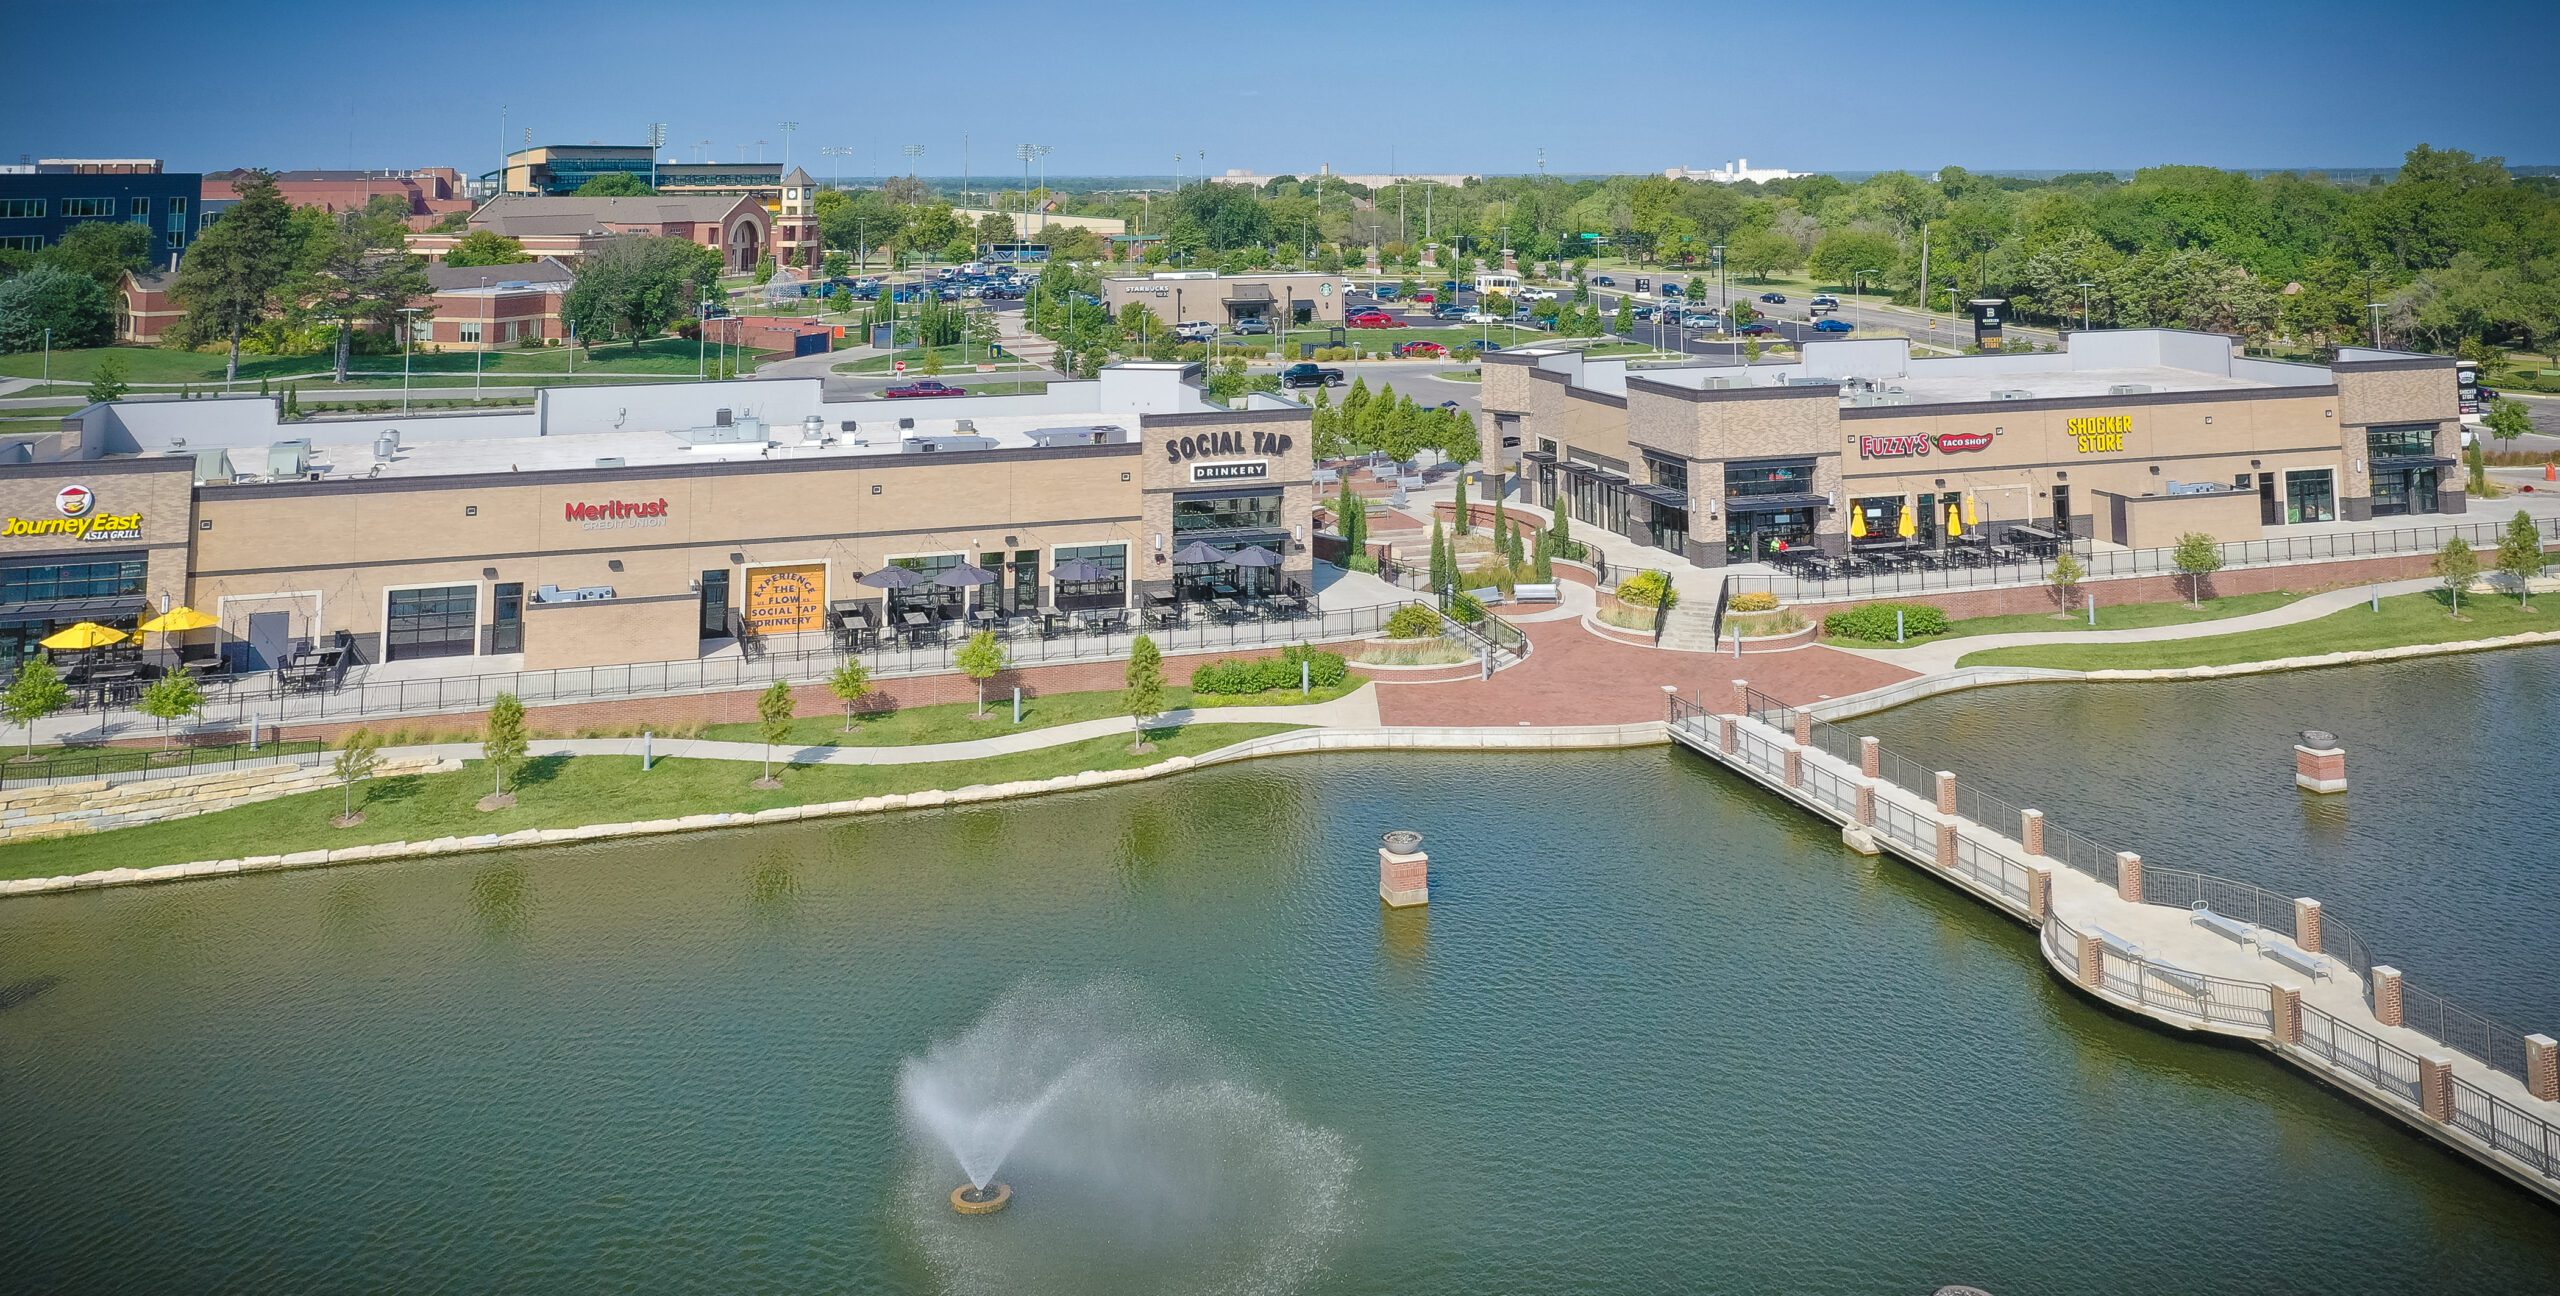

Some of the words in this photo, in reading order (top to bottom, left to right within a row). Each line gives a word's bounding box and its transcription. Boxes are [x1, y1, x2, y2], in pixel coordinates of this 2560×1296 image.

[1125, 285, 1169, 293] STARBUCKS
[2067, 415, 2132, 436] SHOCKER
[1165, 431, 1246, 464] SOCIAL
[1252, 431, 1293, 457] TAP
[1860, 432, 1930, 459] FUZZY'S
[1964, 438, 1987, 446] SHOP
[2078, 434, 2123, 453] STORE
[1196, 465, 1264, 477] DRINKERY
[565, 498, 669, 522] Meritrust
[1, 517, 94, 540] Journey
[92, 512, 143, 532] East
[583, 520, 626, 531] CREDIT
[629, 517, 667, 528] UNION
[83, 531, 108, 540] ASIA
[110, 530, 141, 539] GRILL
[754, 572, 815, 598] EXPERIENCE
[773, 585, 795, 593] THE
[768, 596, 800, 605] FLOW
[751, 607, 792, 617] SOCIAL
[796, 605, 817, 613] TAP
[756, 616, 811, 628] DRINKERY
